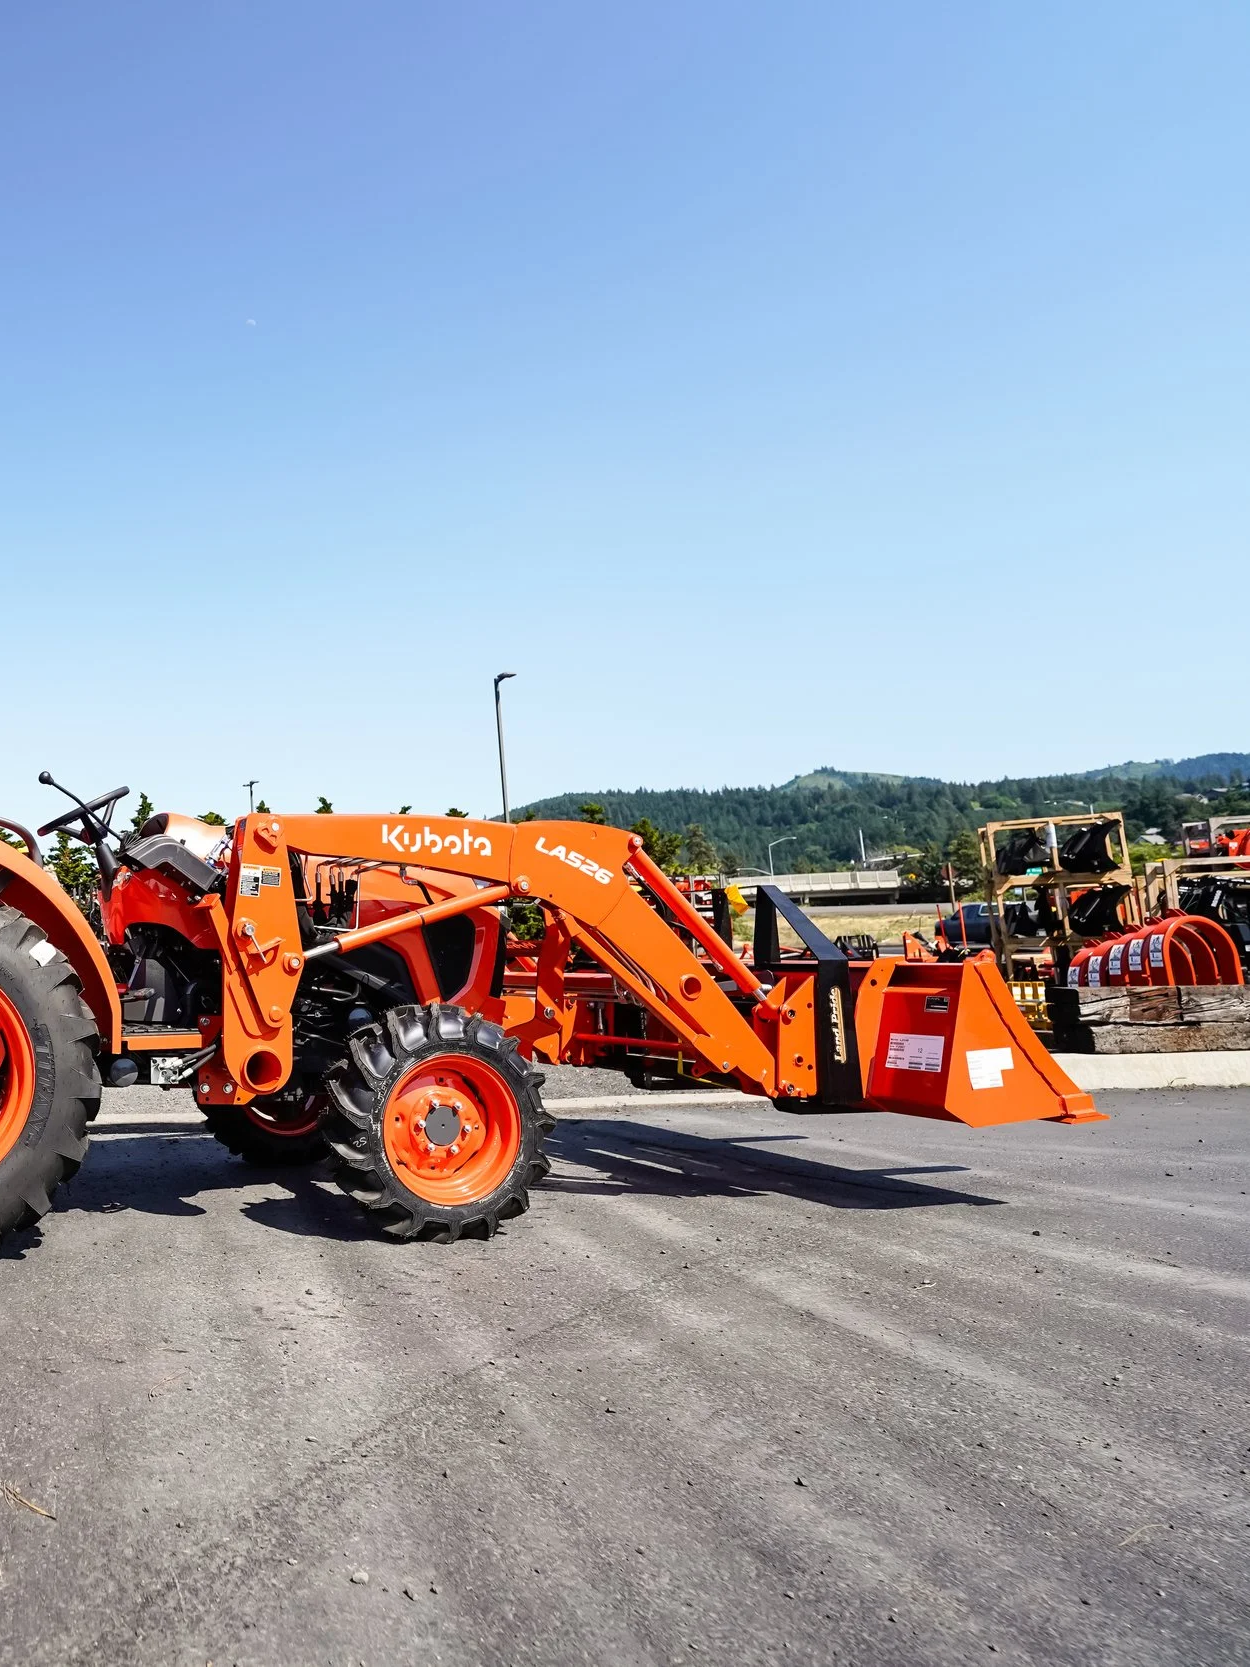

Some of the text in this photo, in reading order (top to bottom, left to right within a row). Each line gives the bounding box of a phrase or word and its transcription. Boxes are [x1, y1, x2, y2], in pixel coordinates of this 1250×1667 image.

[381, 823, 492, 857] Kubota
[534, 836, 614, 885] LA526
[829, 987, 847, 1063] Land Pride
